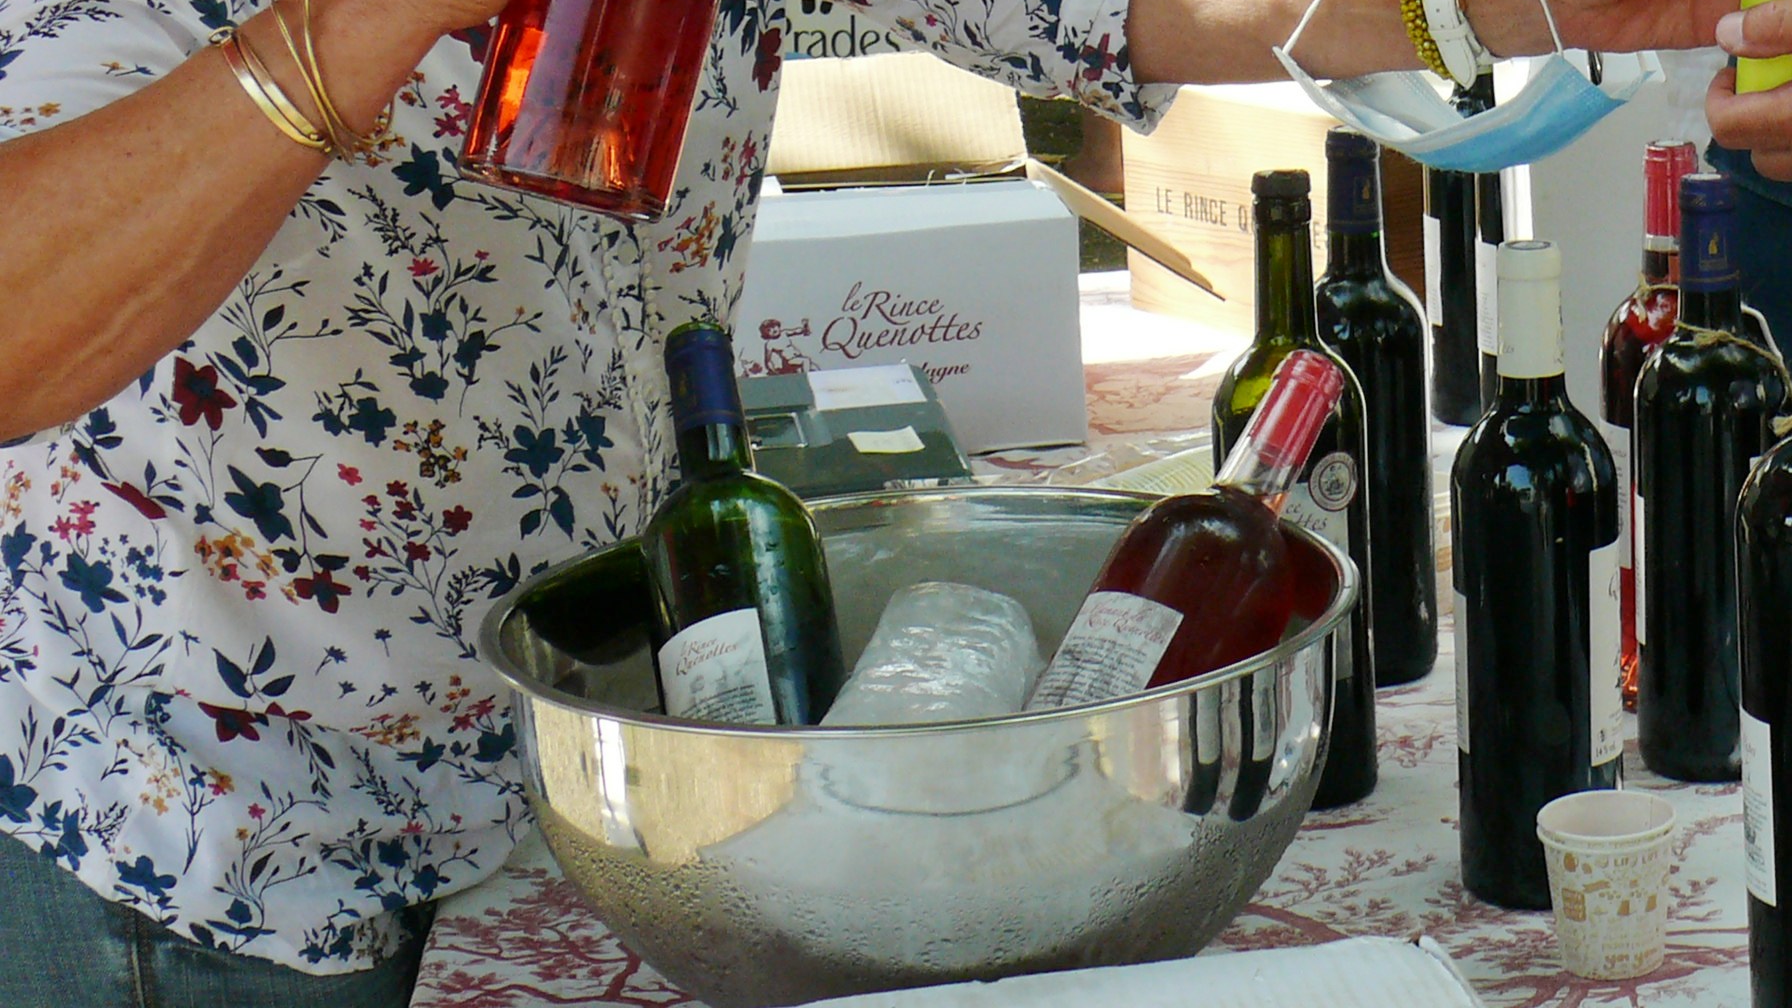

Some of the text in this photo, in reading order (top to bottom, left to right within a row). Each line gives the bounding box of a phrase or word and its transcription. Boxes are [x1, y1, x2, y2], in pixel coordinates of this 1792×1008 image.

[785, 14, 900, 59] rades
[1156, 186, 1173, 216] LE
[1184, 192, 1227, 227] RINCE
[841, 281, 944, 326] le Rince
[819, 313, 983, 359] Quenottes
